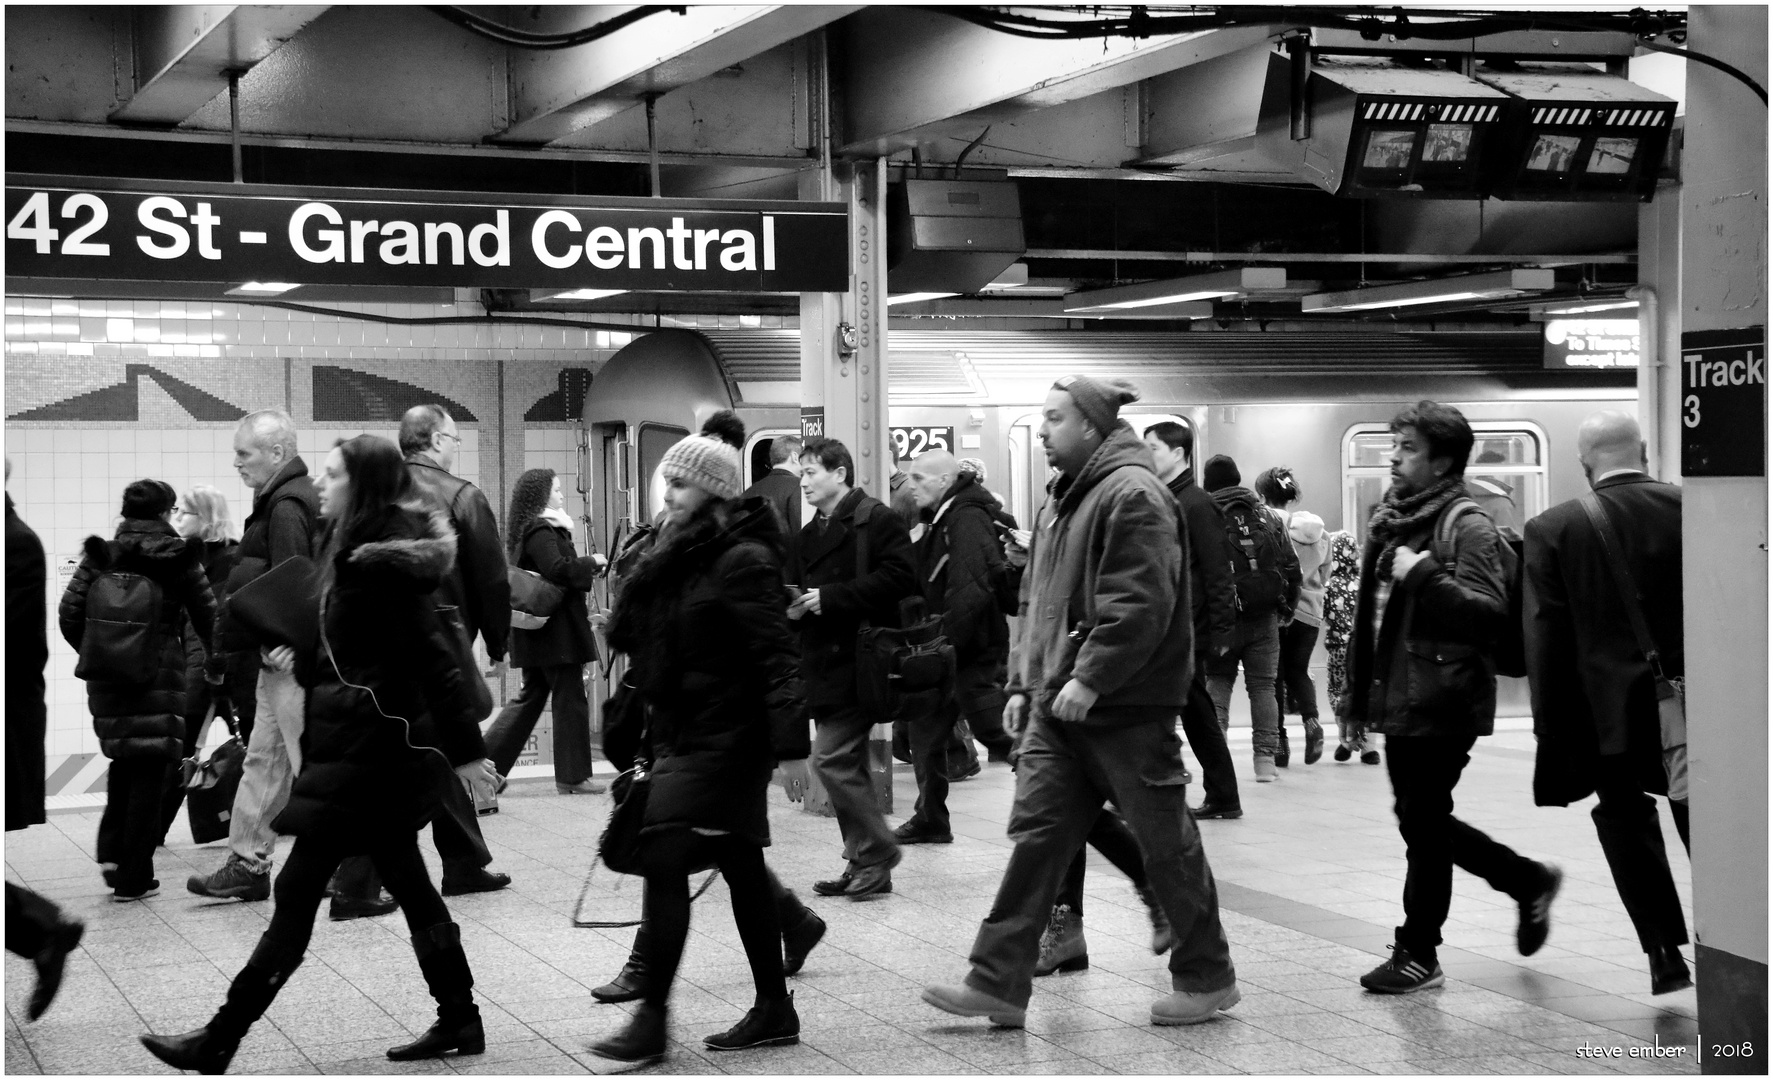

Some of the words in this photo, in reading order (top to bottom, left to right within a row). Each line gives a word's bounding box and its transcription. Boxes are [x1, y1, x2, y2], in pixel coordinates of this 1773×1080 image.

[8, 192, 110, 256] 42
[136, 196, 222, 260] St
[239, 231, 267, 244] -
[288, 202, 511, 266] Grand
[531, 209, 776, 271] Central
[1566, 336, 1585, 351] To
[1683, 350, 1764, 388] Track
[801, 417, 823, 437] Track
[1683, 394, 1701, 428] 3
[893, 428, 948, 458] 925
